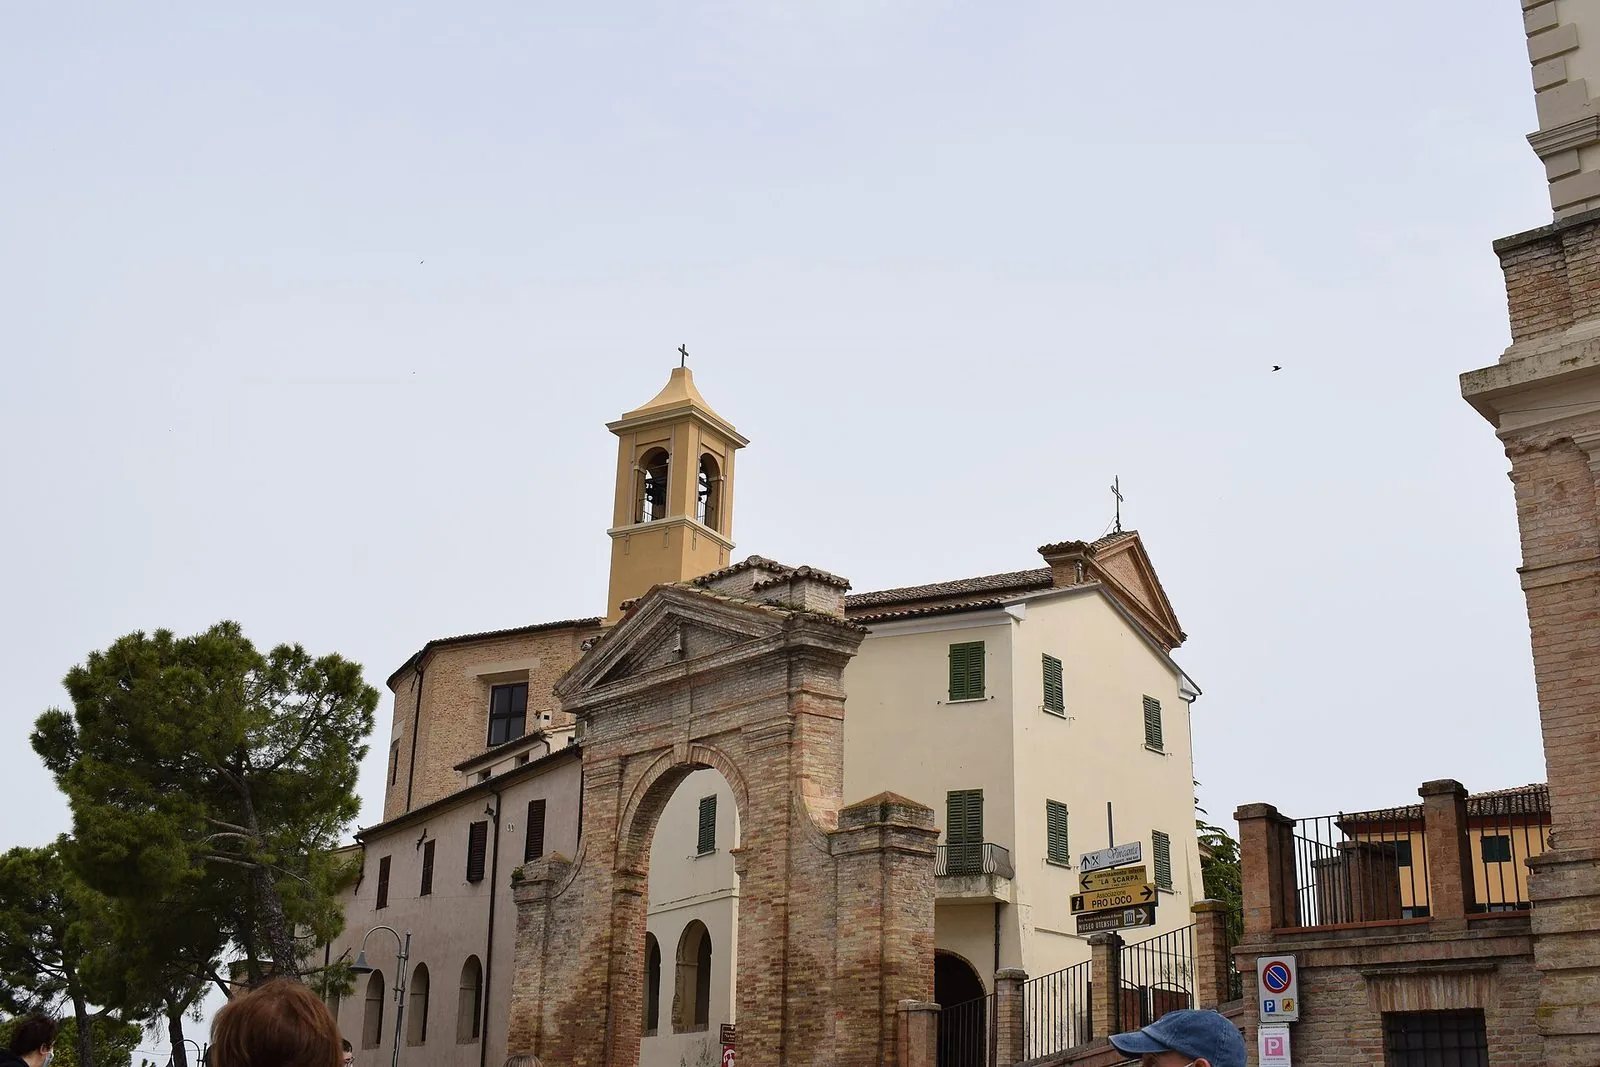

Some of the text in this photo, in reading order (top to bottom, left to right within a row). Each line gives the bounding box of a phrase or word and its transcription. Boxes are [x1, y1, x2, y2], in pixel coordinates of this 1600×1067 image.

[1096, 889, 1127, 899] Associazione
[1091, 895, 1132, 909] PRO LOCO
[1078, 919, 1119, 931] MUSEO UTENSILIA
[1266, 1001, 1274, 1011] P
[1267, 1039, 1280, 1055] P
